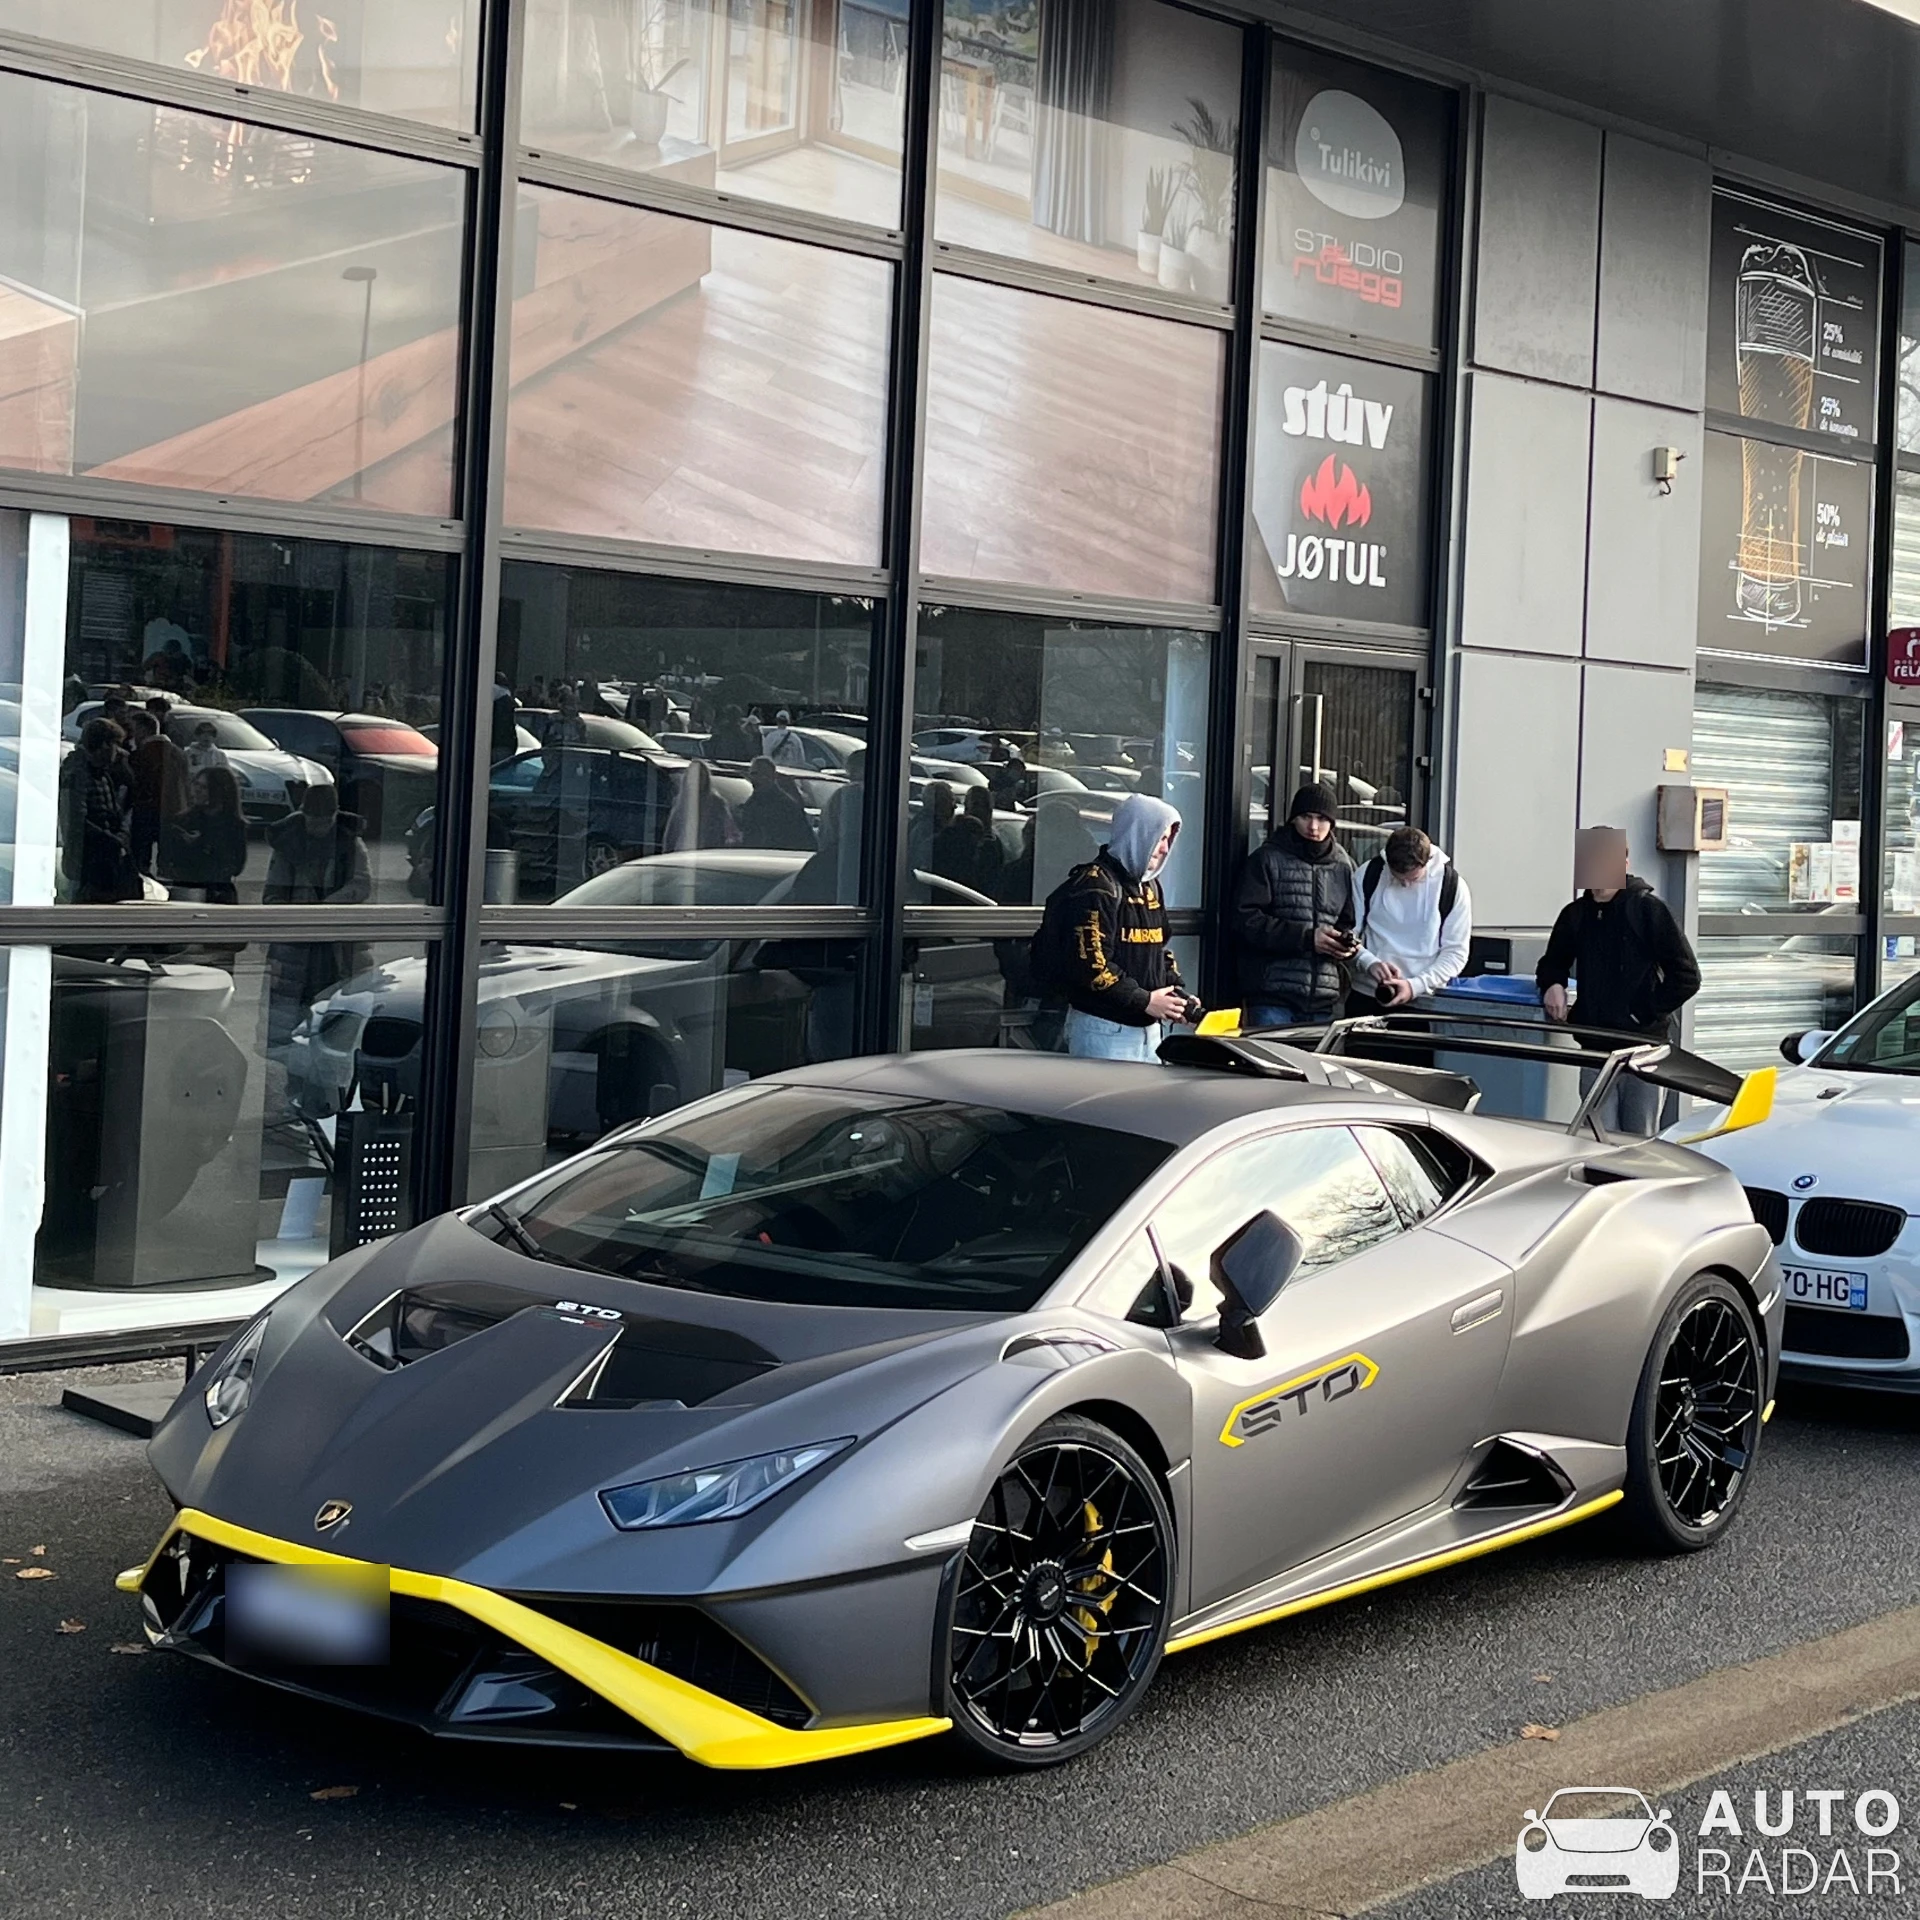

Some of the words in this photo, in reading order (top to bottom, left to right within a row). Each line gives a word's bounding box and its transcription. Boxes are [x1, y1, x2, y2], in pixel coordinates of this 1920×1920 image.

[1318, 143, 1390, 188] Tulikivi
[1294, 228, 1403, 275] STUDIO
[1816, 502, 1840, 527] 50%
[1278, 533, 1386, 588] JØTUL
[555, 1300, 622, 1320] STO
[1241, 1364, 1359, 1438] STO
